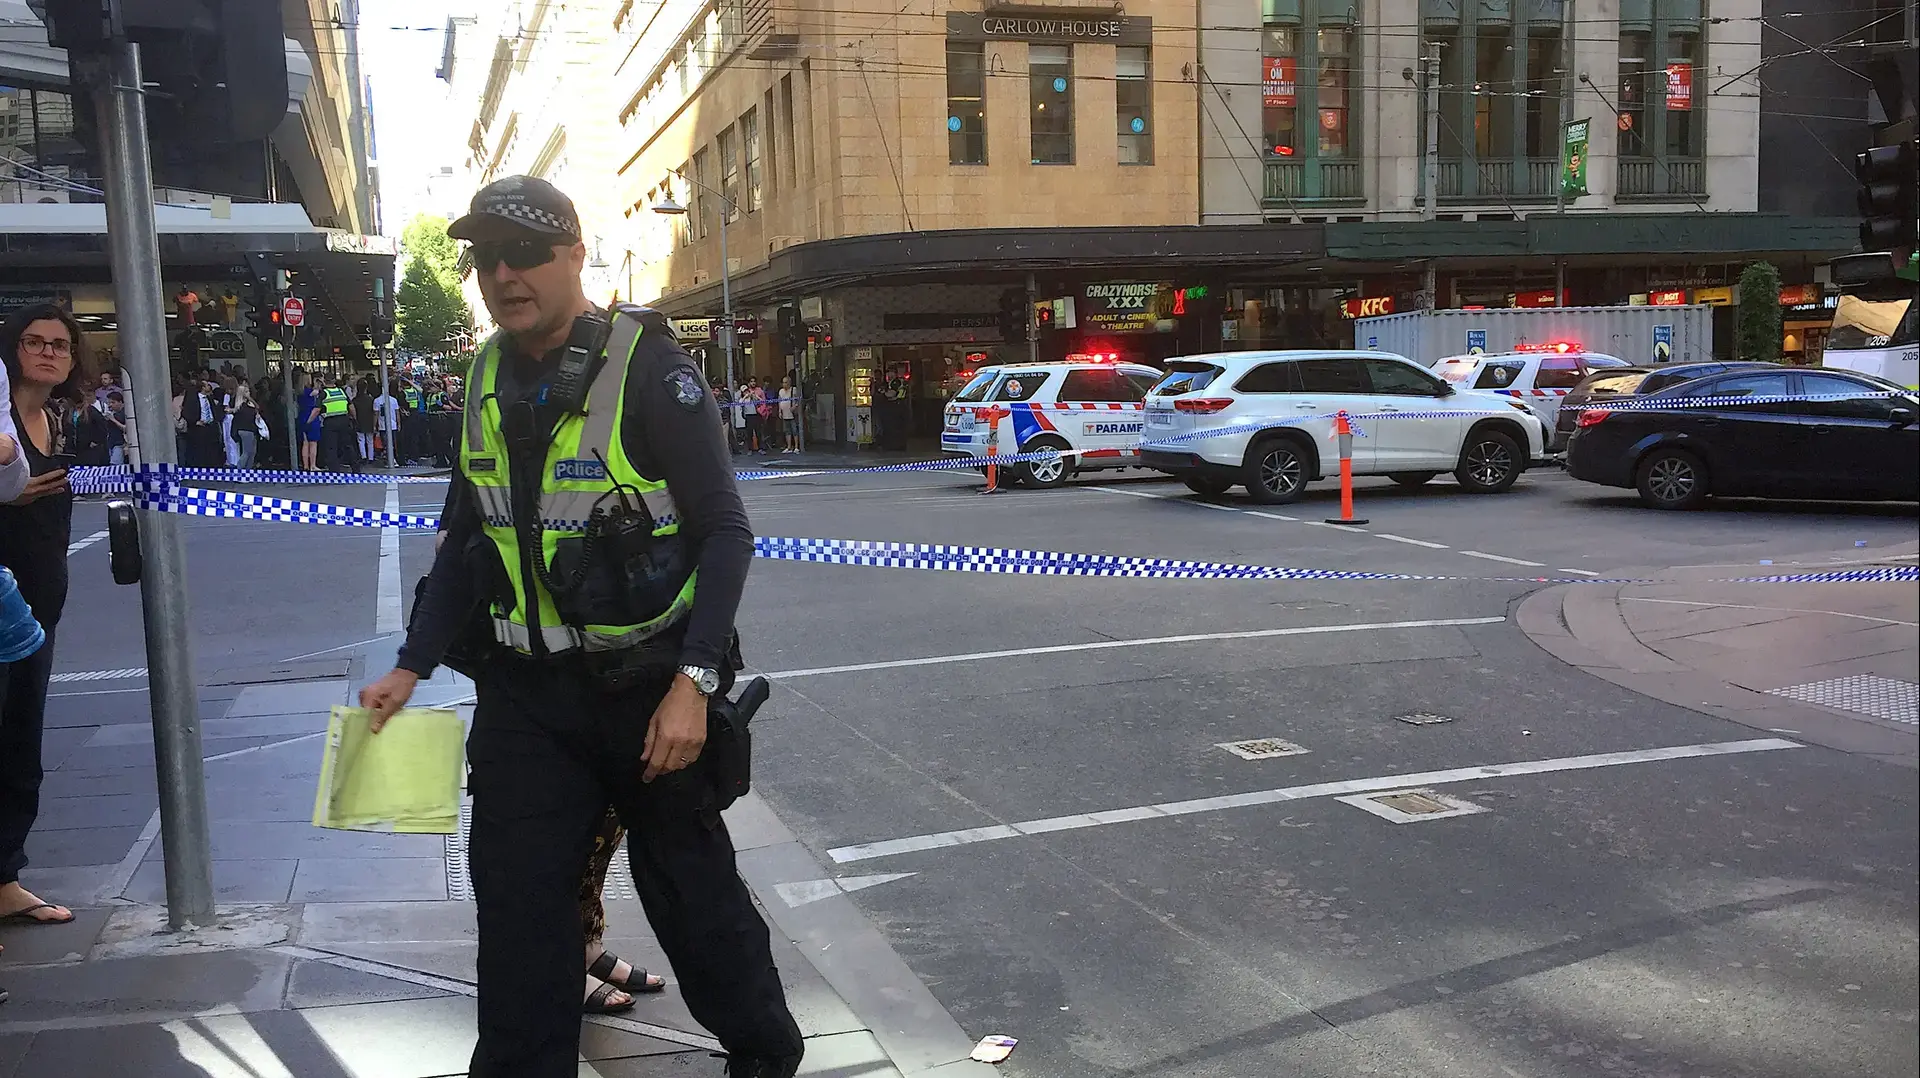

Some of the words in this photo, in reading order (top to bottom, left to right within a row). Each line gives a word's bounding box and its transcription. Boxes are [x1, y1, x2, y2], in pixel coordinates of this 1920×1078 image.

[982, 17, 1055, 34] CARLOW
[1061, 20, 1120, 37] HOUSE
[1567, 122, 1587, 134] MERRY
[1086, 283, 1159, 298] CRAZYHORSE
[1106, 296, 1145, 309] XXX
[1360, 297, 1390, 316] KFC
[1091, 314, 1118, 322] ADULT
[680, 325, 709, 333] UGG
[1107, 322, 1145, 330] THEATRE
[208, 340, 243, 352] UGG
[1870, 336, 1889, 346] 205
[1902, 352, 1919, 361] 205
[555, 462, 604, 478] Police
